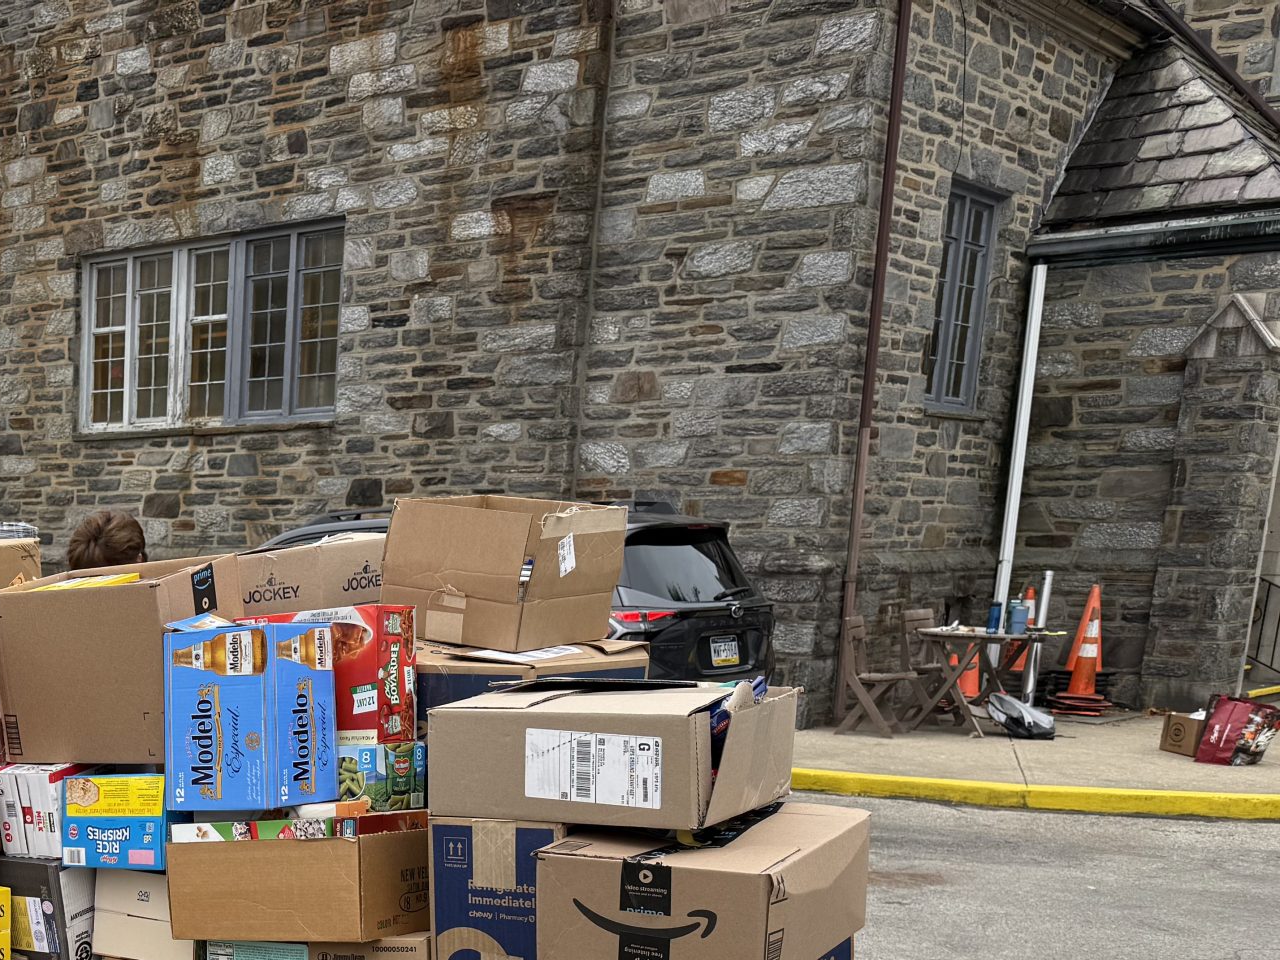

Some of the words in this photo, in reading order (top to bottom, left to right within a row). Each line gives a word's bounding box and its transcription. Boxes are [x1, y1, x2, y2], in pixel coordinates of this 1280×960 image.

[193, 568, 212, 582] prime
[342, 573, 382, 592] JOCKE
[242, 585, 300, 604] JOCKEY
[228, 633, 239, 672] Modelo
[391, 643, 400, 704] BOYARDEE
[191, 699, 214, 786] Modelo
[292, 693, 310, 782] Modelo
[638, 742, 651, 752] G
[362, 751, 371, 763] 8
[176, 784, 185, 802] 12
[280, 784, 289, 802] 12
[36, 811, 44, 832] MILK
[86, 825, 131, 841] KRISPIES
[96, 841, 120, 853] RICE
[640, 887, 668, 895] streaming
[468, 894, 536, 908] Immediatel
[469, 910, 493, 920] chewy
[499, 914, 528, 923] Pharmacy
